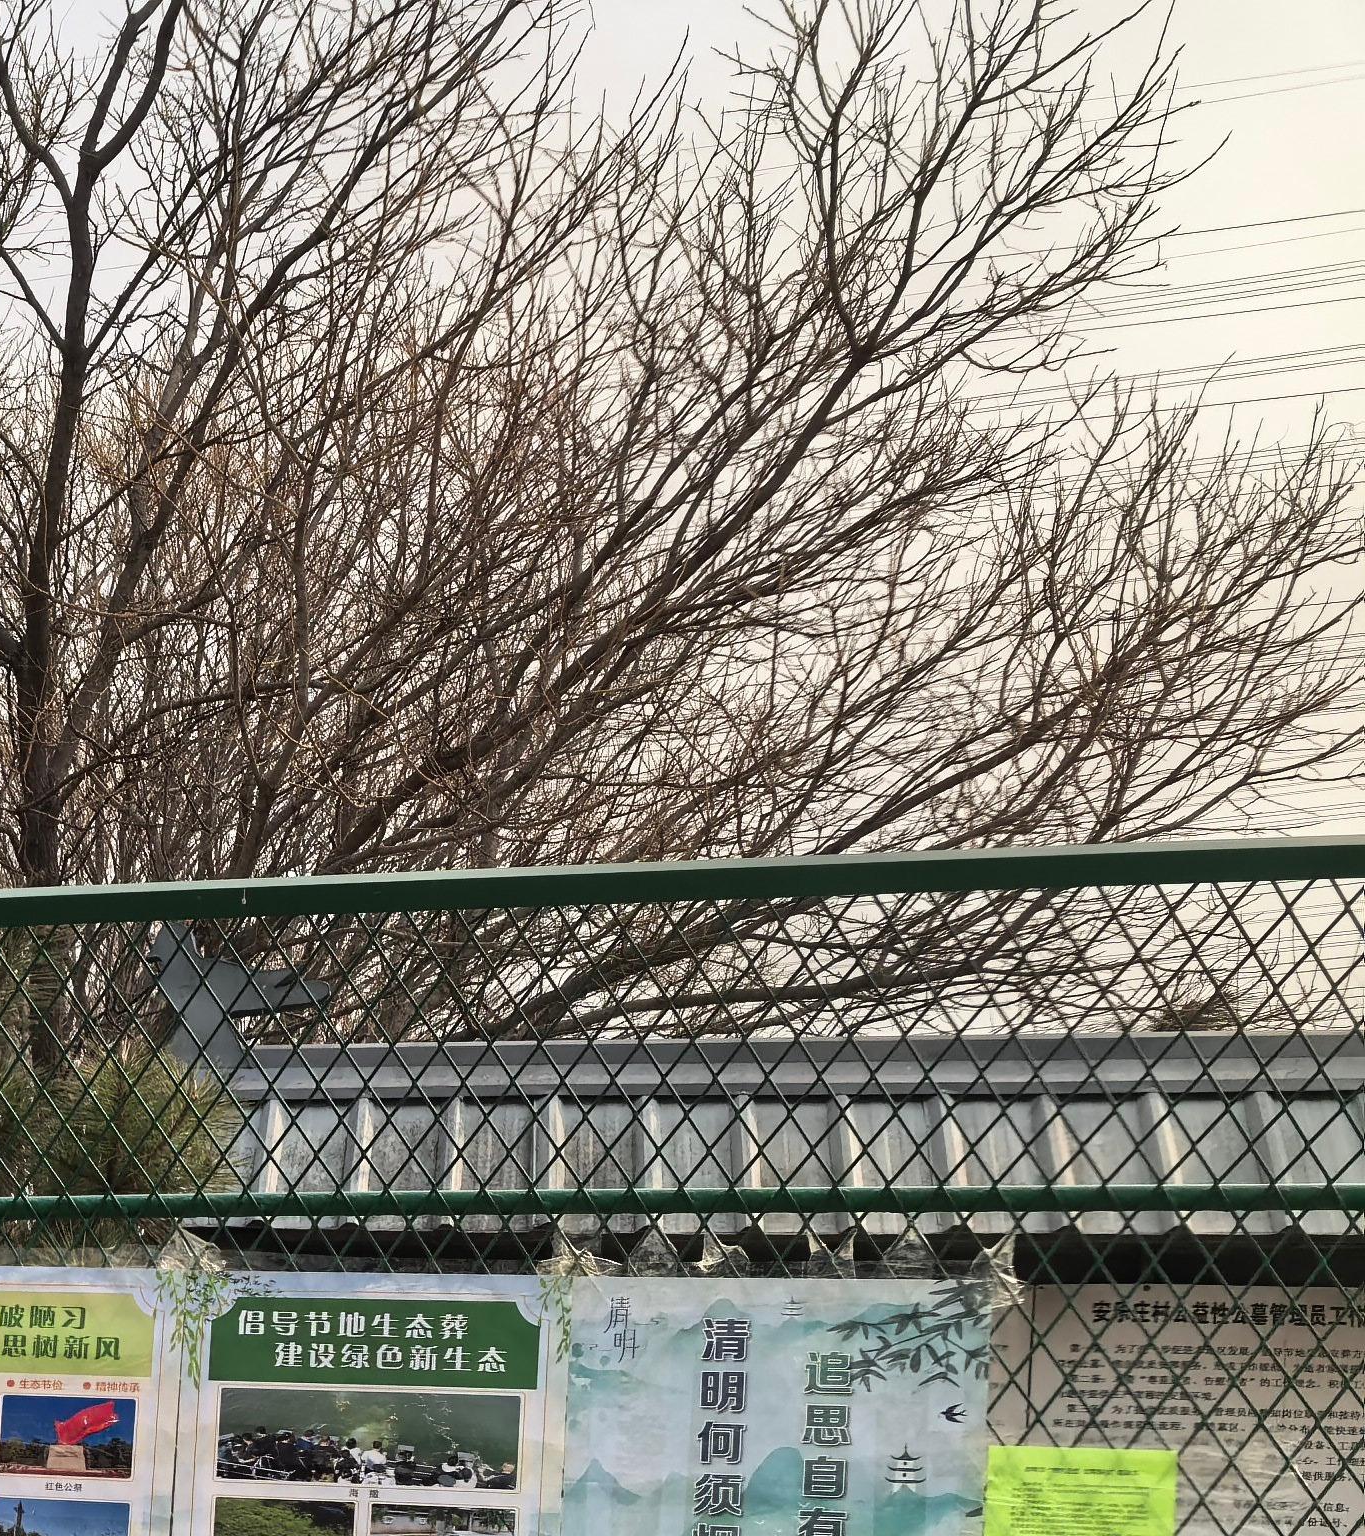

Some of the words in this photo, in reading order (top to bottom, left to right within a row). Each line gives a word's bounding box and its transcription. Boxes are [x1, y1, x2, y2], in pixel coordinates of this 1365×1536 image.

[237, 1308, 471, 1341] 倡导节地生态葬
[273, 1341, 508, 1374] 建设绿色新生态
